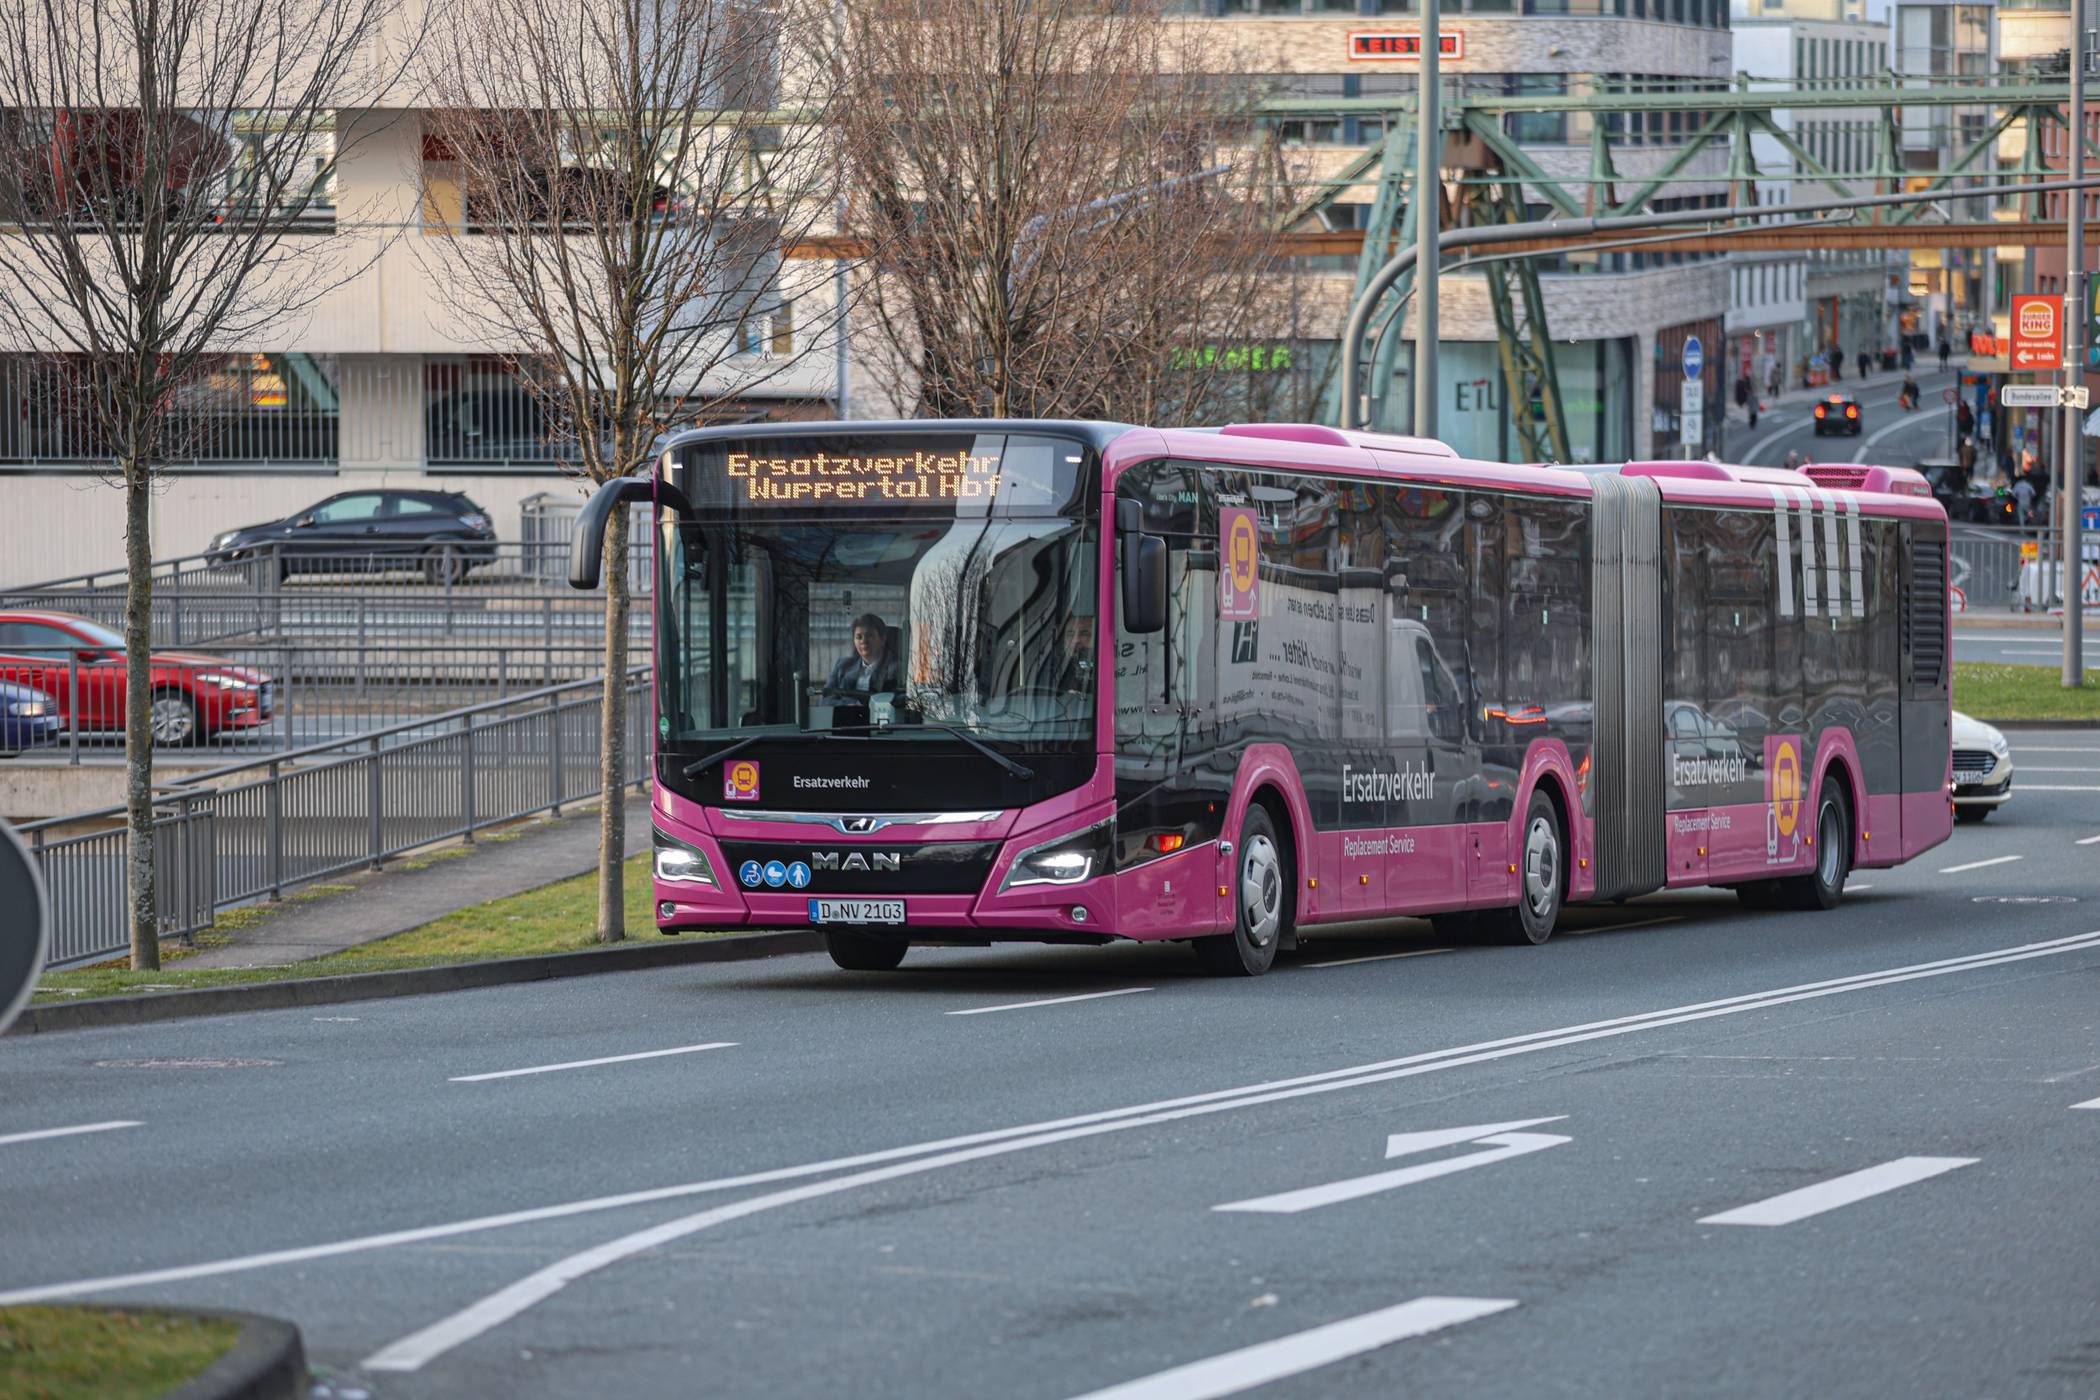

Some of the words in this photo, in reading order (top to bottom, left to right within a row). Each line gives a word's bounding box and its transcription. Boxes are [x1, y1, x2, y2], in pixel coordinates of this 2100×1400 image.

[1354, 37, 1455, 53] LEISTR
[2022, 320, 2051, 330] KING
[727, 451, 1000, 478] Ersatzverkehr
[748, 475, 929, 501] Wuppertal
[939, 475, 1001, 499] Hbf
[1178, 491, 1199, 503] MAN
[1673, 748, 1746, 786] Ersatzverkehr
[793, 775, 870, 789] Ersatzverkehr
[1343, 760, 1435, 802] Ersatzverkehr
[1674, 815, 1710, 836] Replacement
[1711, 812, 1730, 830] Service
[1344, 835, 1388, 861] Replacement
[1389, 833, 1414, 854] Service
[811, 852, 900, 871] MAN
[821, 903, 831, 919] D
[840, 903, 860, 919] NV
[863, 903, 902, 919] 2103
